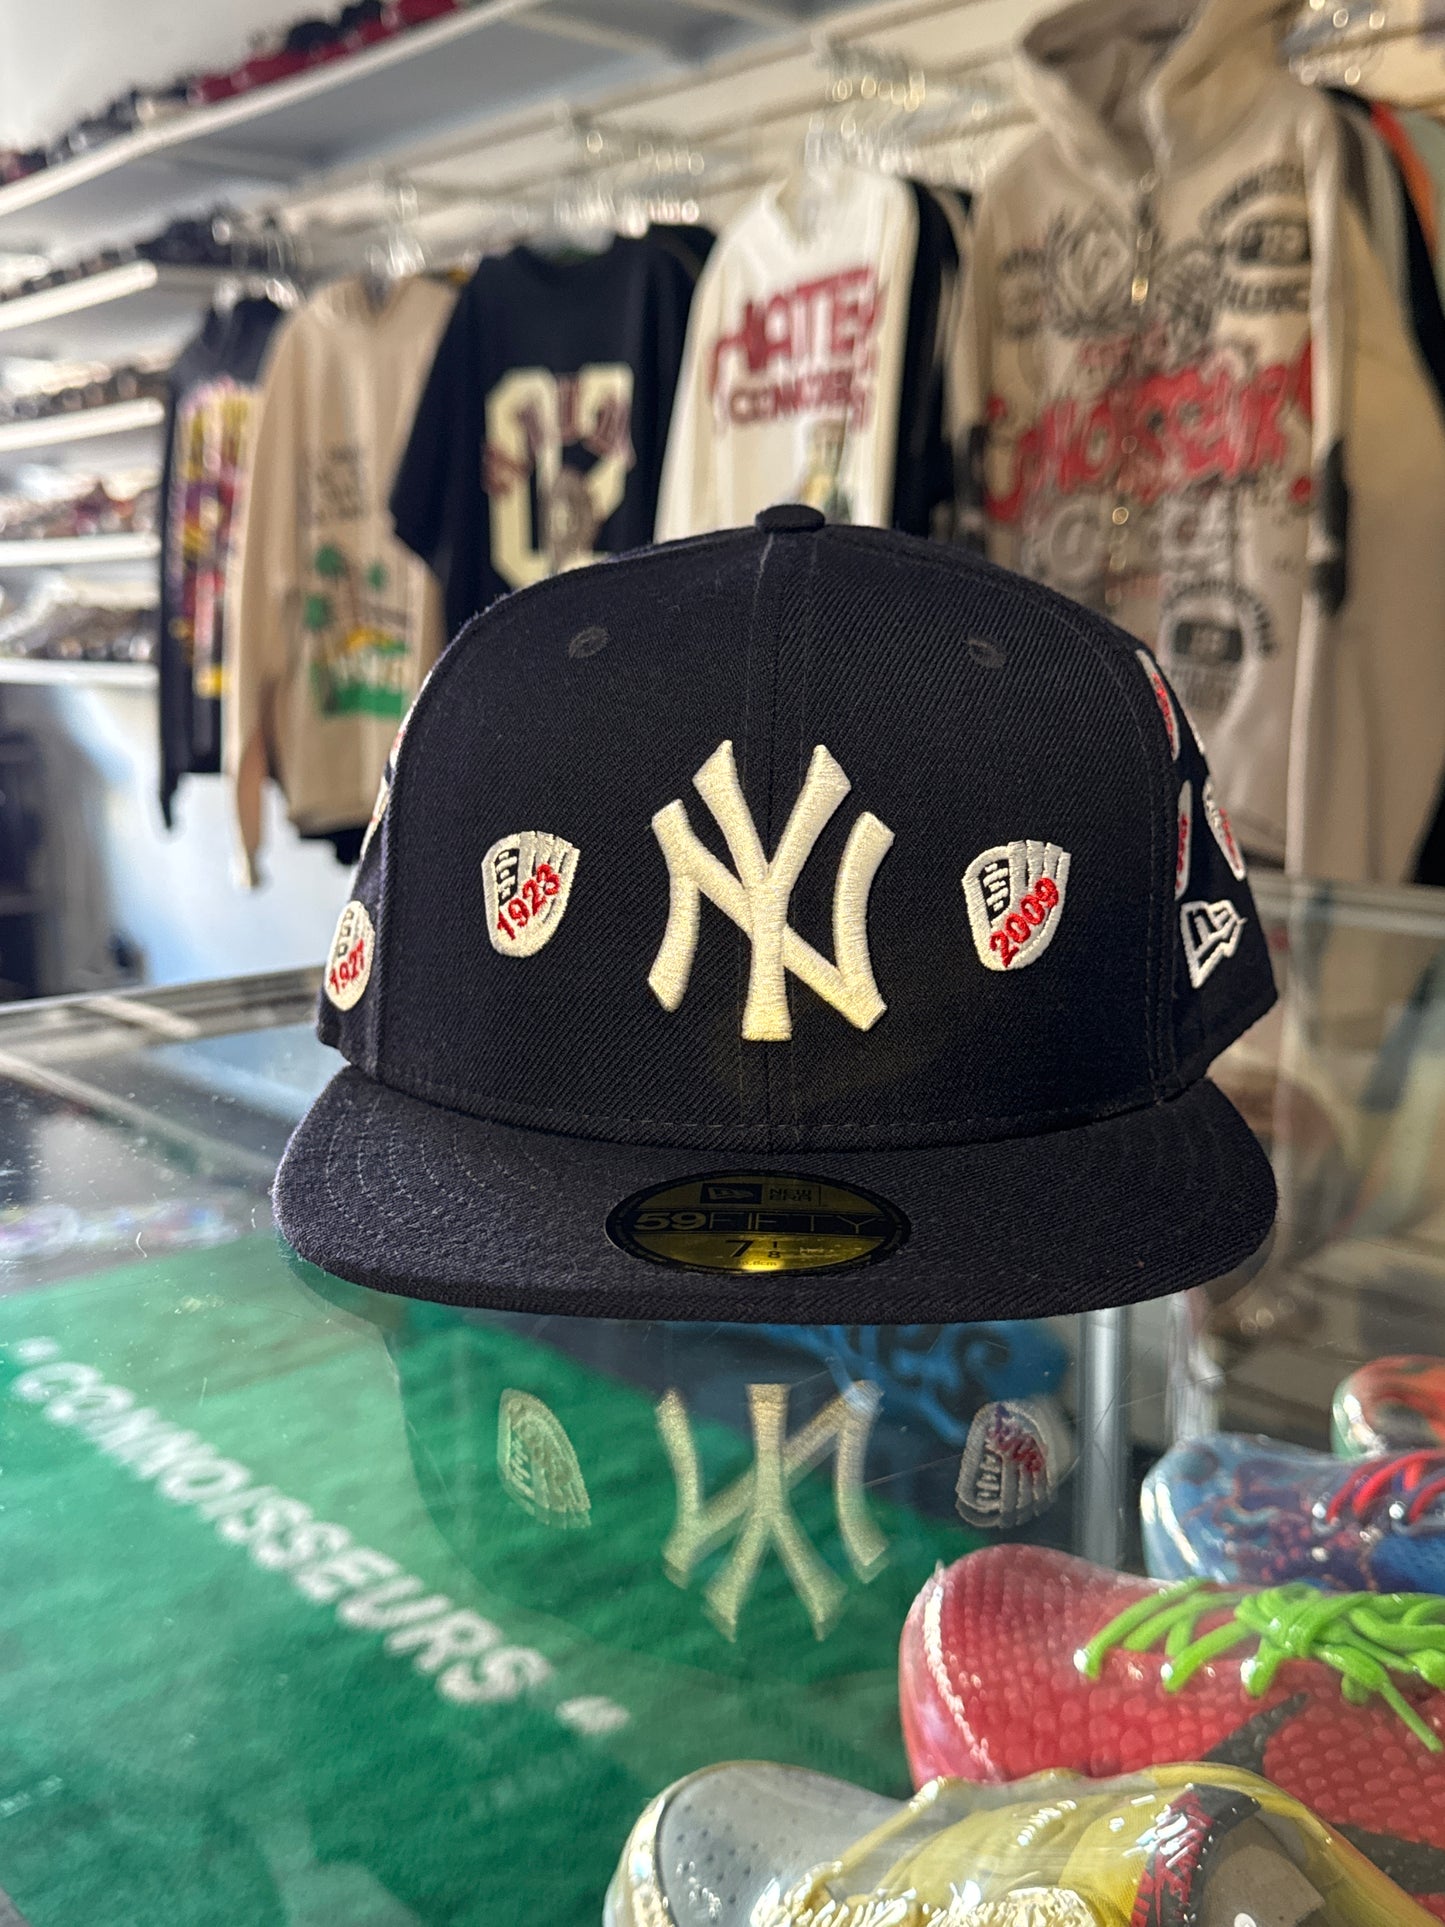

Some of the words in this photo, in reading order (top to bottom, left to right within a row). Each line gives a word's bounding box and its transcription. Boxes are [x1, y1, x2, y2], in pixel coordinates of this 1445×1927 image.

[497, 863, 560, 941] 1923
[648, 740, 895, 1042] NY
[990, 877, 1059, 968] 2009
[633, 1211, 879, 1234] 59FIFTY
[725, 1239, 755, 1258] 7
